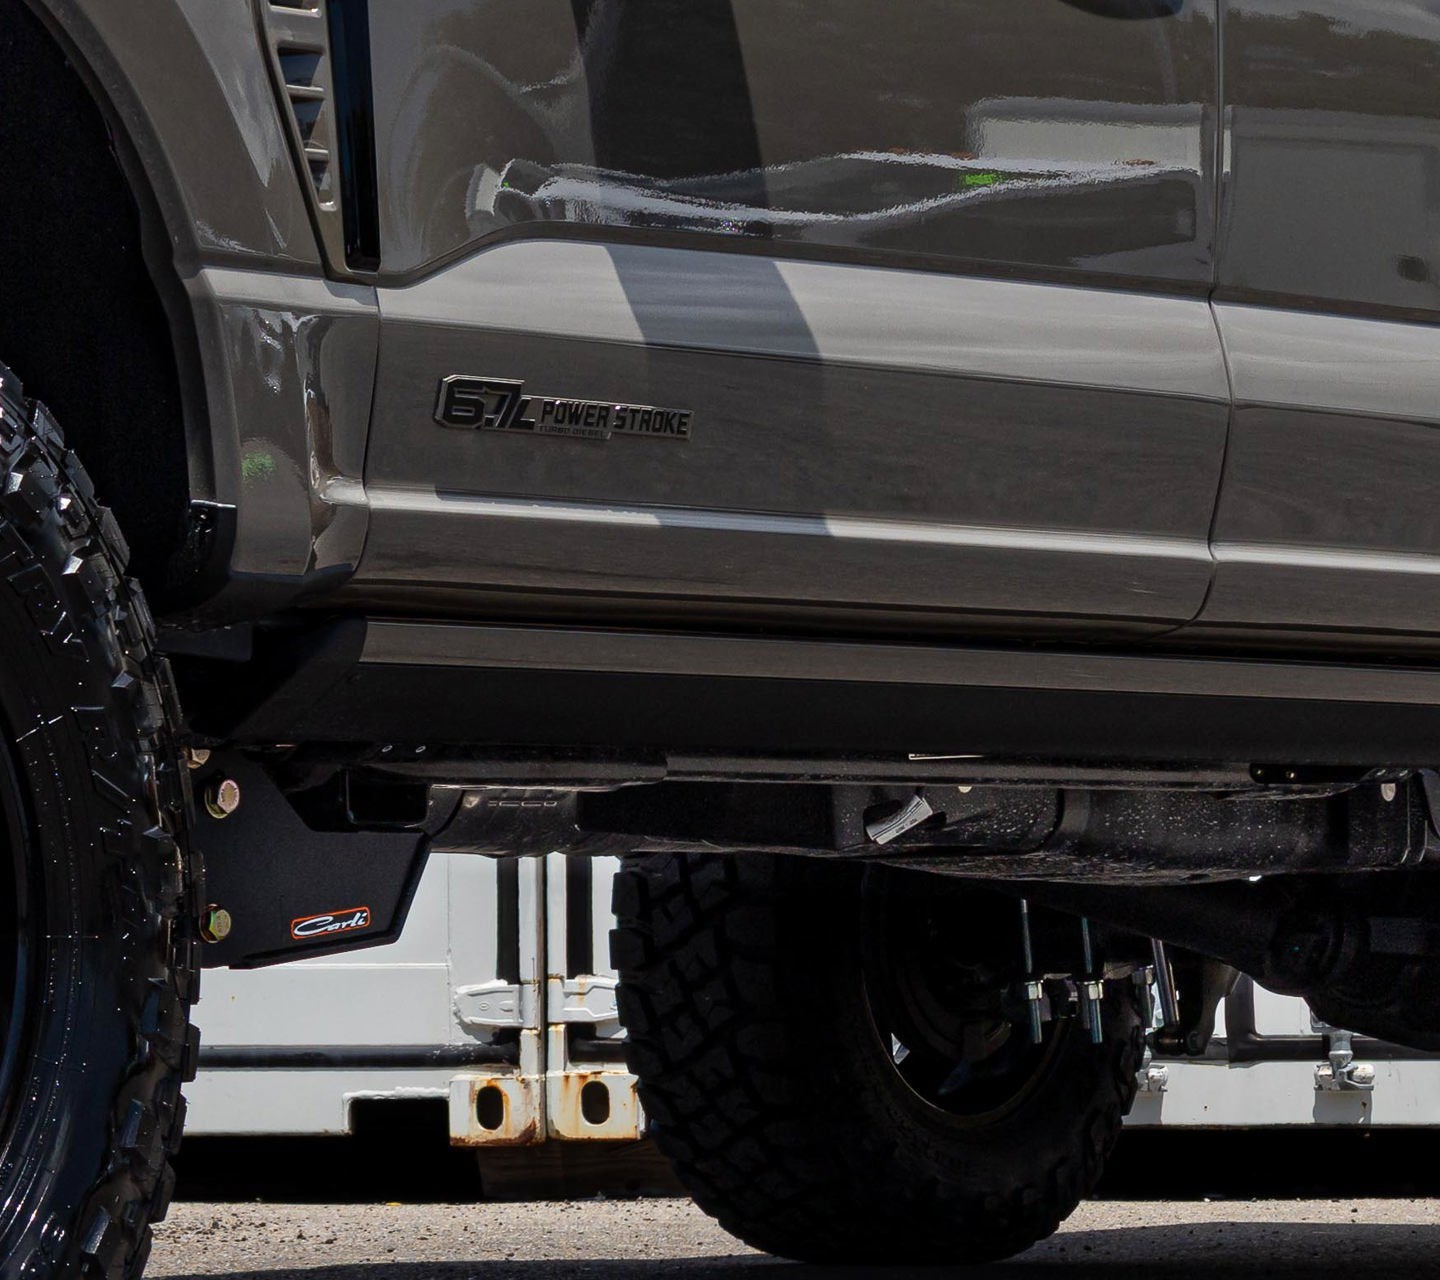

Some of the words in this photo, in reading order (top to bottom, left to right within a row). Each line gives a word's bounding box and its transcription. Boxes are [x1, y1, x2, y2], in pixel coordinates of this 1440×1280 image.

[441, 375, 536, 430] 6.7L
[541, 398, 608, 429] POWER
[613, 405, 692, 435] STROKE
[538, 424, 571, 434] TURBO
[573, 428, 606, 438] DIESEL
[293, 911, 367, 936] Carli
